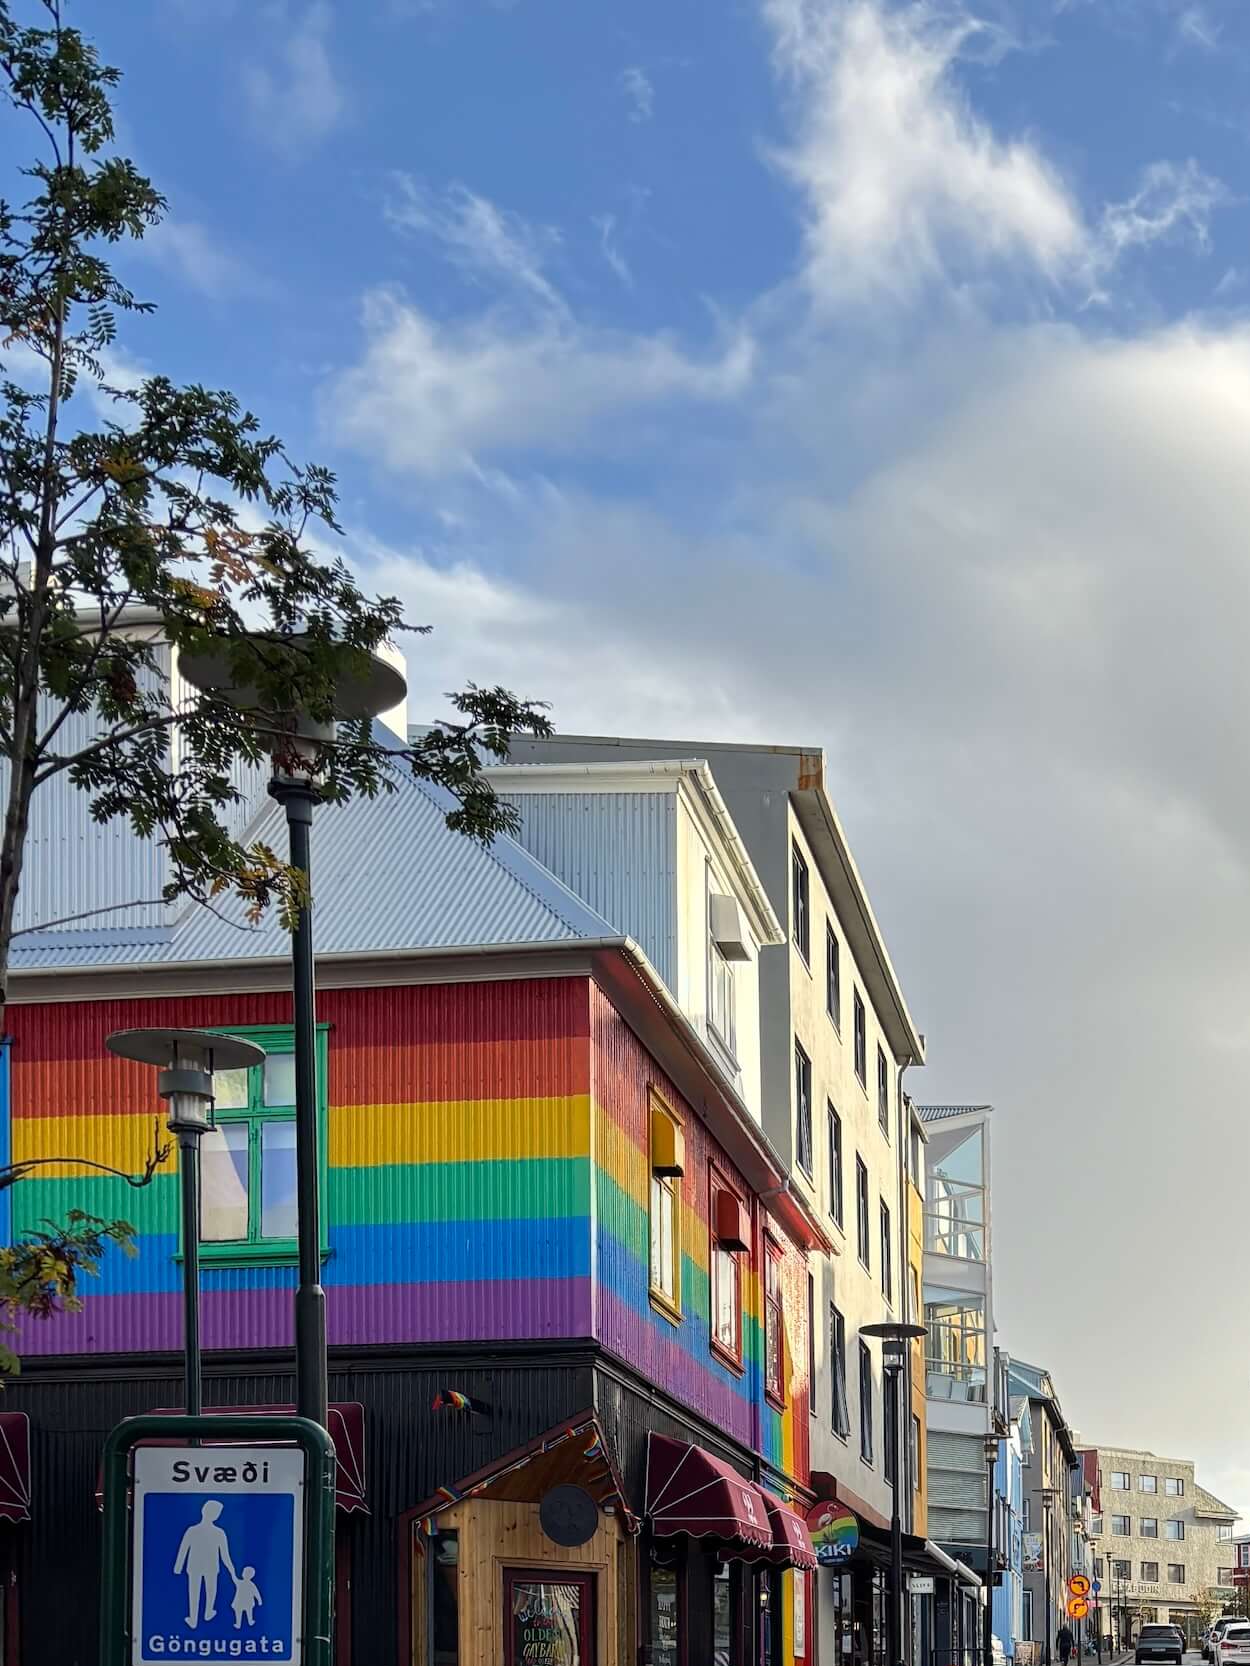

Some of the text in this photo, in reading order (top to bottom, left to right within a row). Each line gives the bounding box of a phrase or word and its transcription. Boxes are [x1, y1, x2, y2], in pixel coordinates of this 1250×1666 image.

[172, 1461, 269, 1483] Svæði
[816, 1543, 851, 1557] KIKI
[149, 1635, 284, 1656] Göngugata
